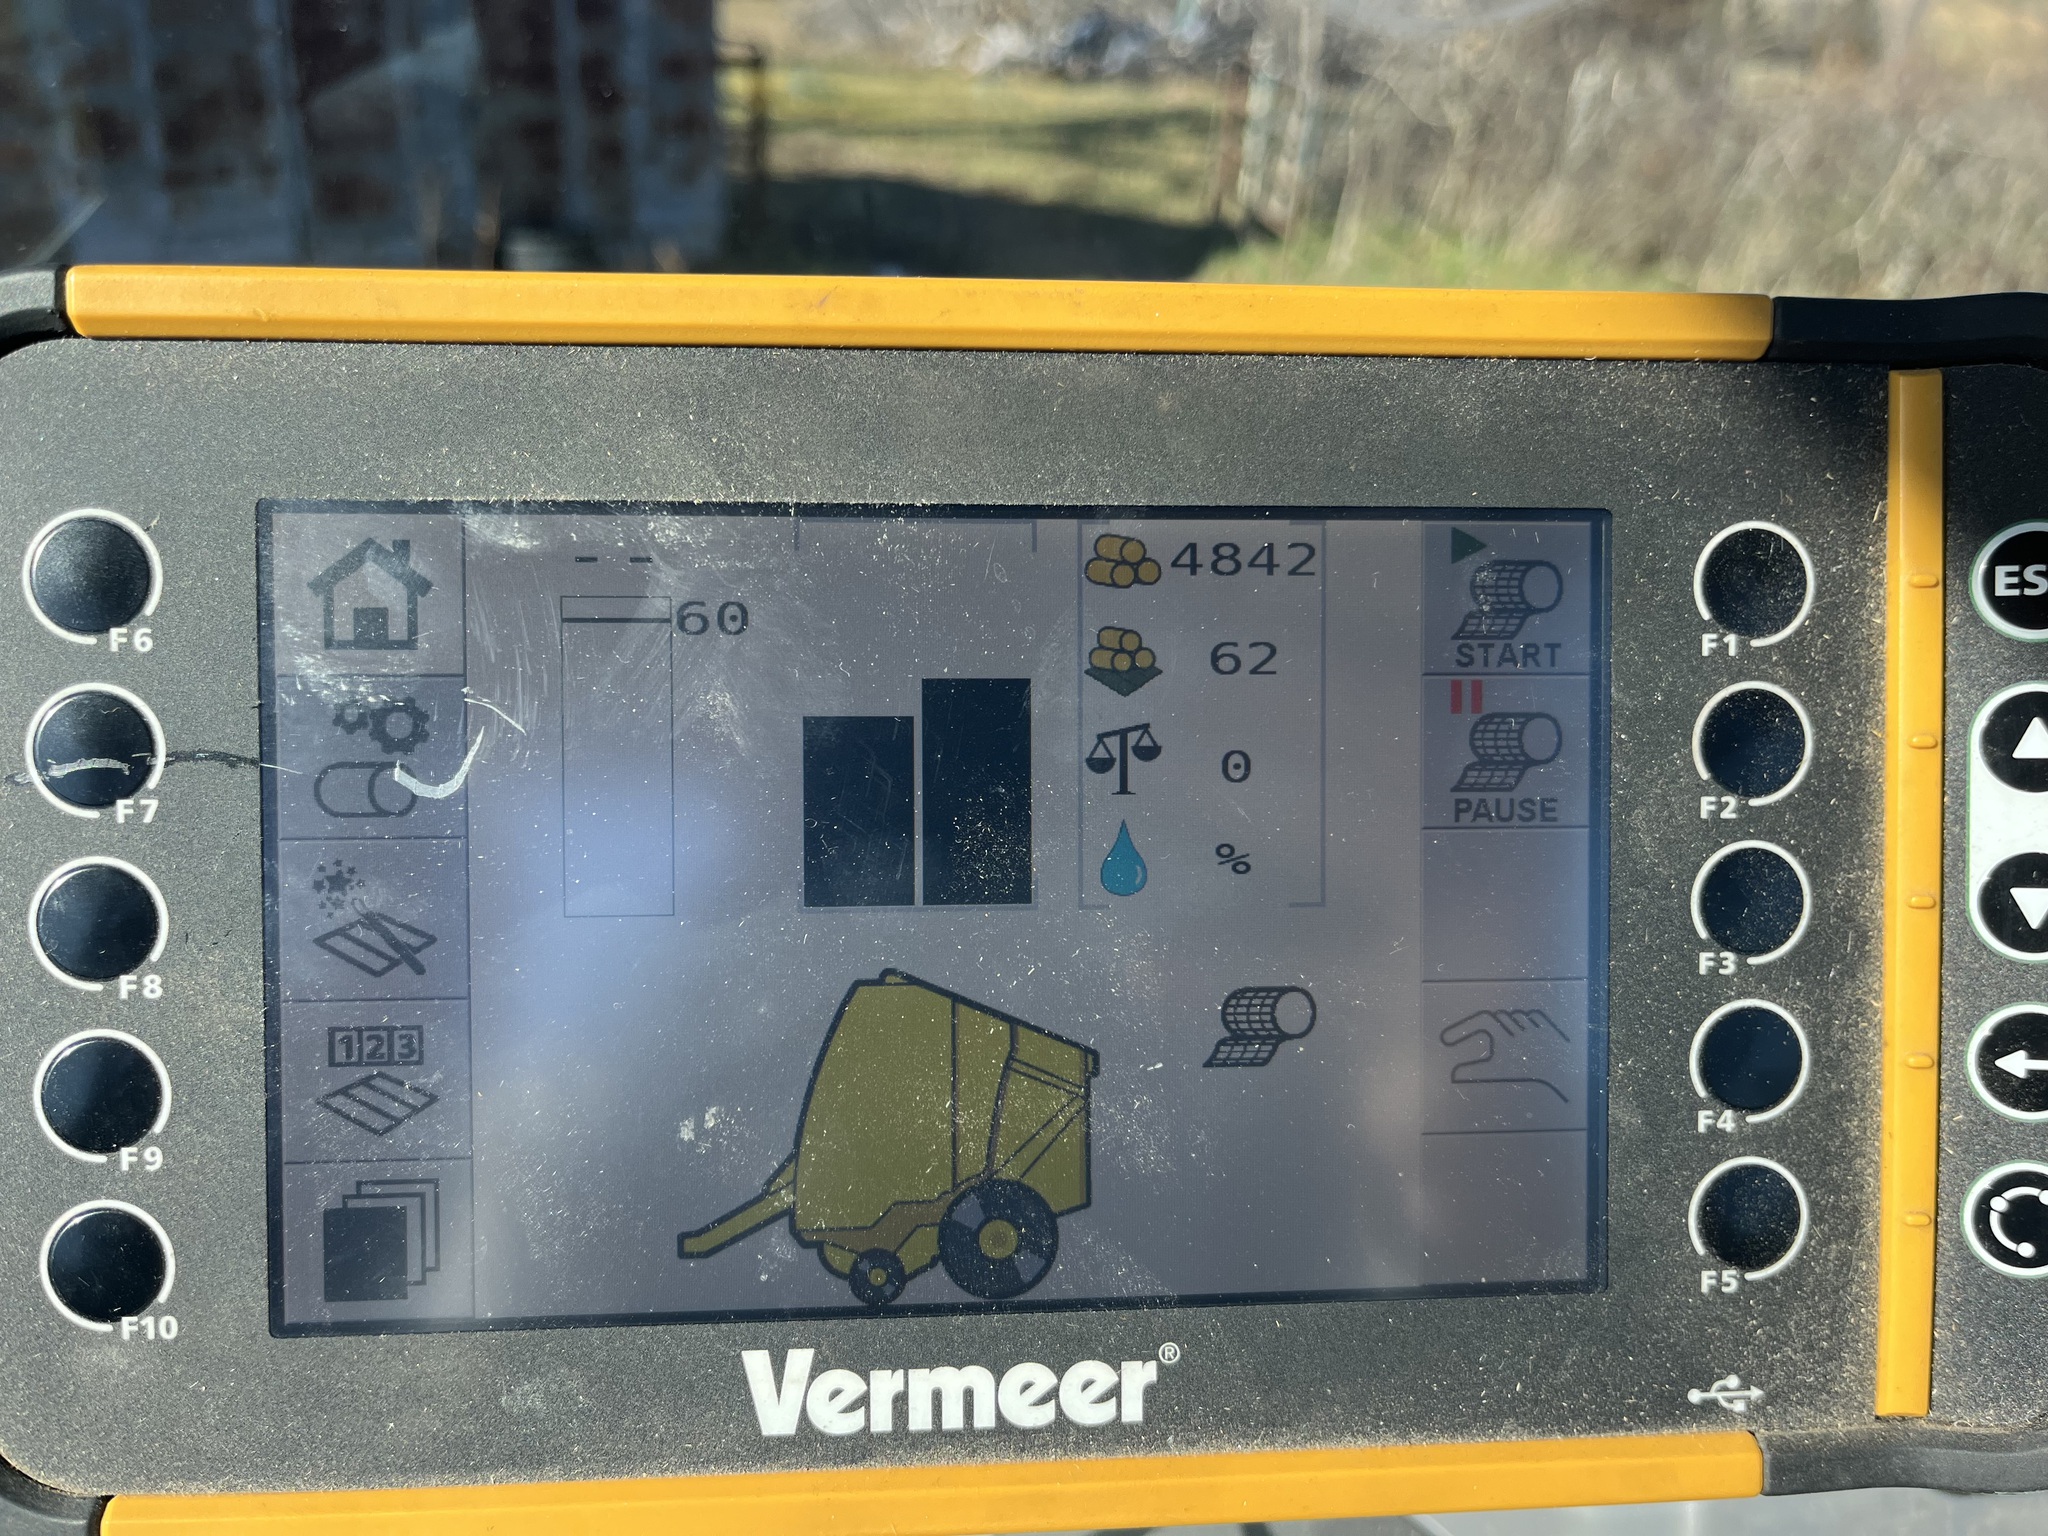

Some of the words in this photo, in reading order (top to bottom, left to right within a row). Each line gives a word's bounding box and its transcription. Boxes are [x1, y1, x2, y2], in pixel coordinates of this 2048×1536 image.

[1170, 541, 1317, 577] 4842
[675, 600, 750, 636] 60
[109, 628, 153, 652] F6
[1701, 632, 1738, 657] F1
[1210, 641, 1278, 676] 62
[1455, 643, 1562, 669] START
[1221, 749, 1252, 784] 0
[116, 800, 158, 824] F7
[1454, 798, 1558, 823] PAUSE
[1699, 795, 1738, 820] F2
[1215, 842, 1252, 875] %
[1698, 952, 1738, 975] F3
[119, 975, 163, 1000] F8
[1697, 1110, 1737, 1133] F4
[120, 1147, 163, 1171] F9
[1700, 1269, 1739, 1293] F5
[121, 1315, 178, 1341] F10
